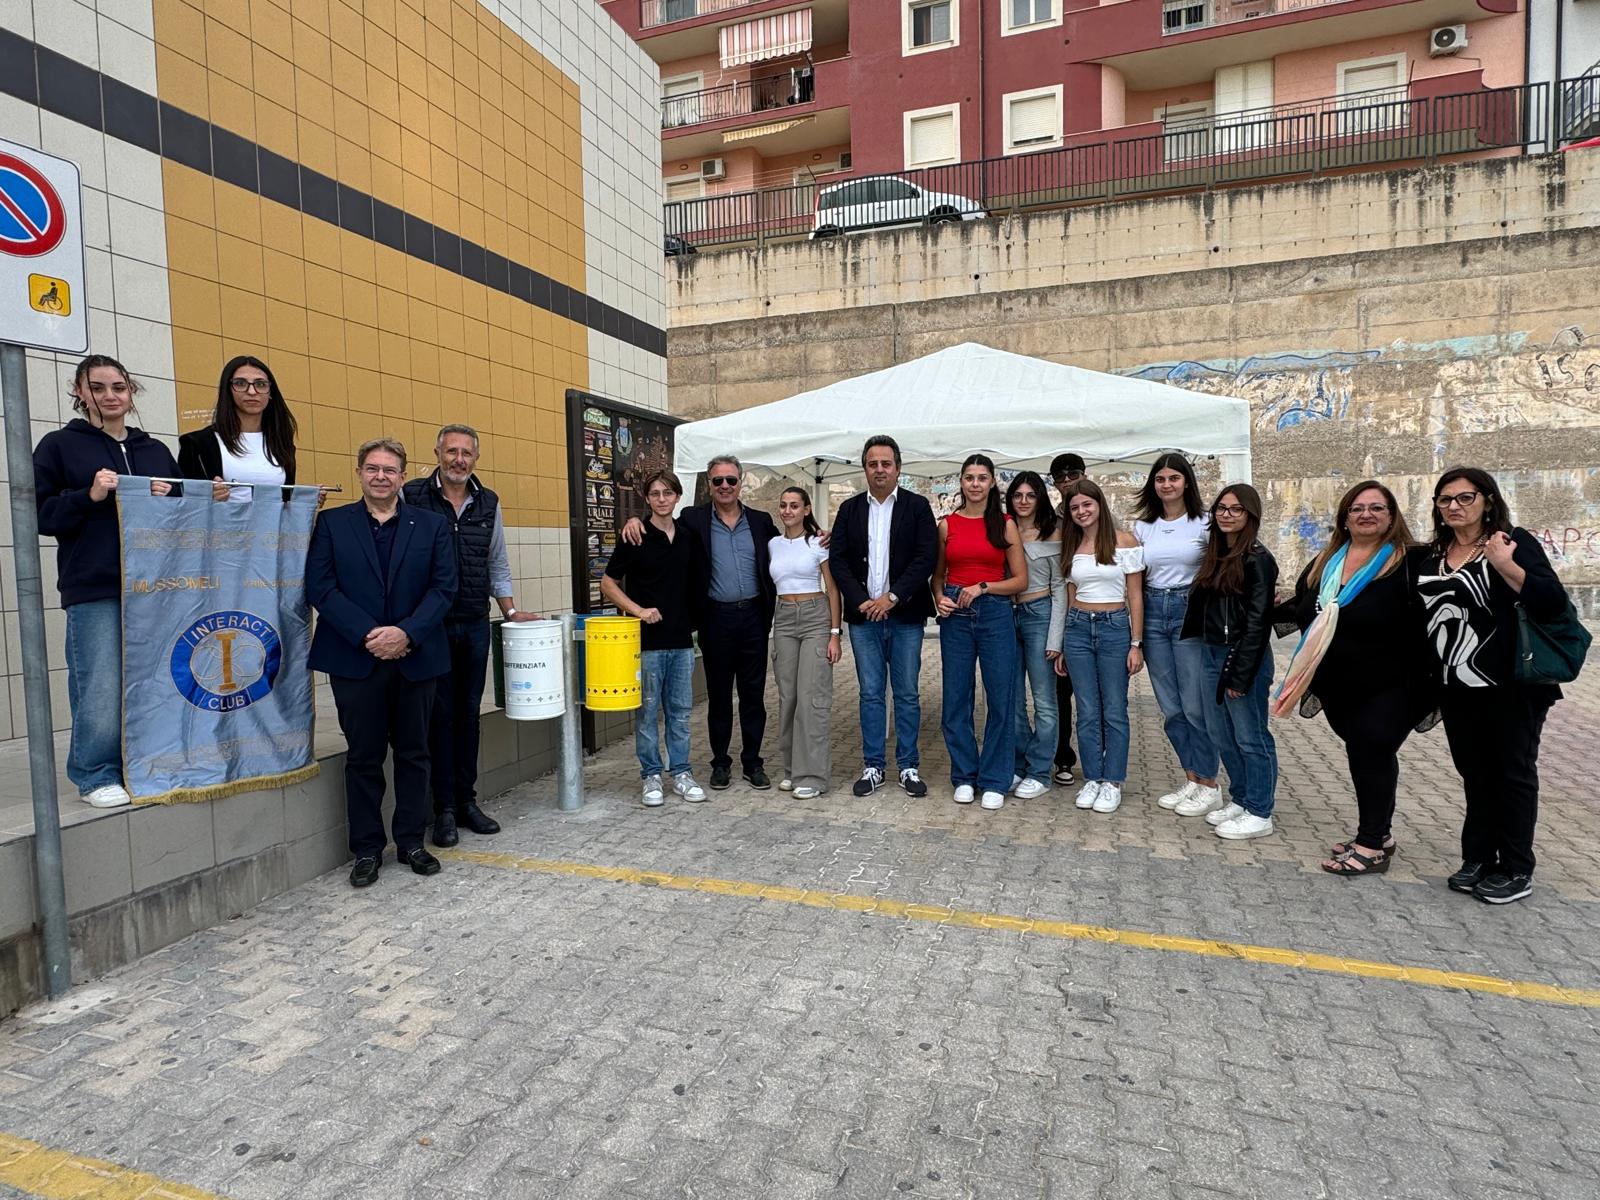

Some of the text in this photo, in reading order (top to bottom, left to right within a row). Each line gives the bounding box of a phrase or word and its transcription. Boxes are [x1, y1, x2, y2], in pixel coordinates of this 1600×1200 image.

[132, 576, 221, 593] MUSSOMELI
[190, 615, 272, 640] INTERACT
[208, 696, 245, 710] CLUB
